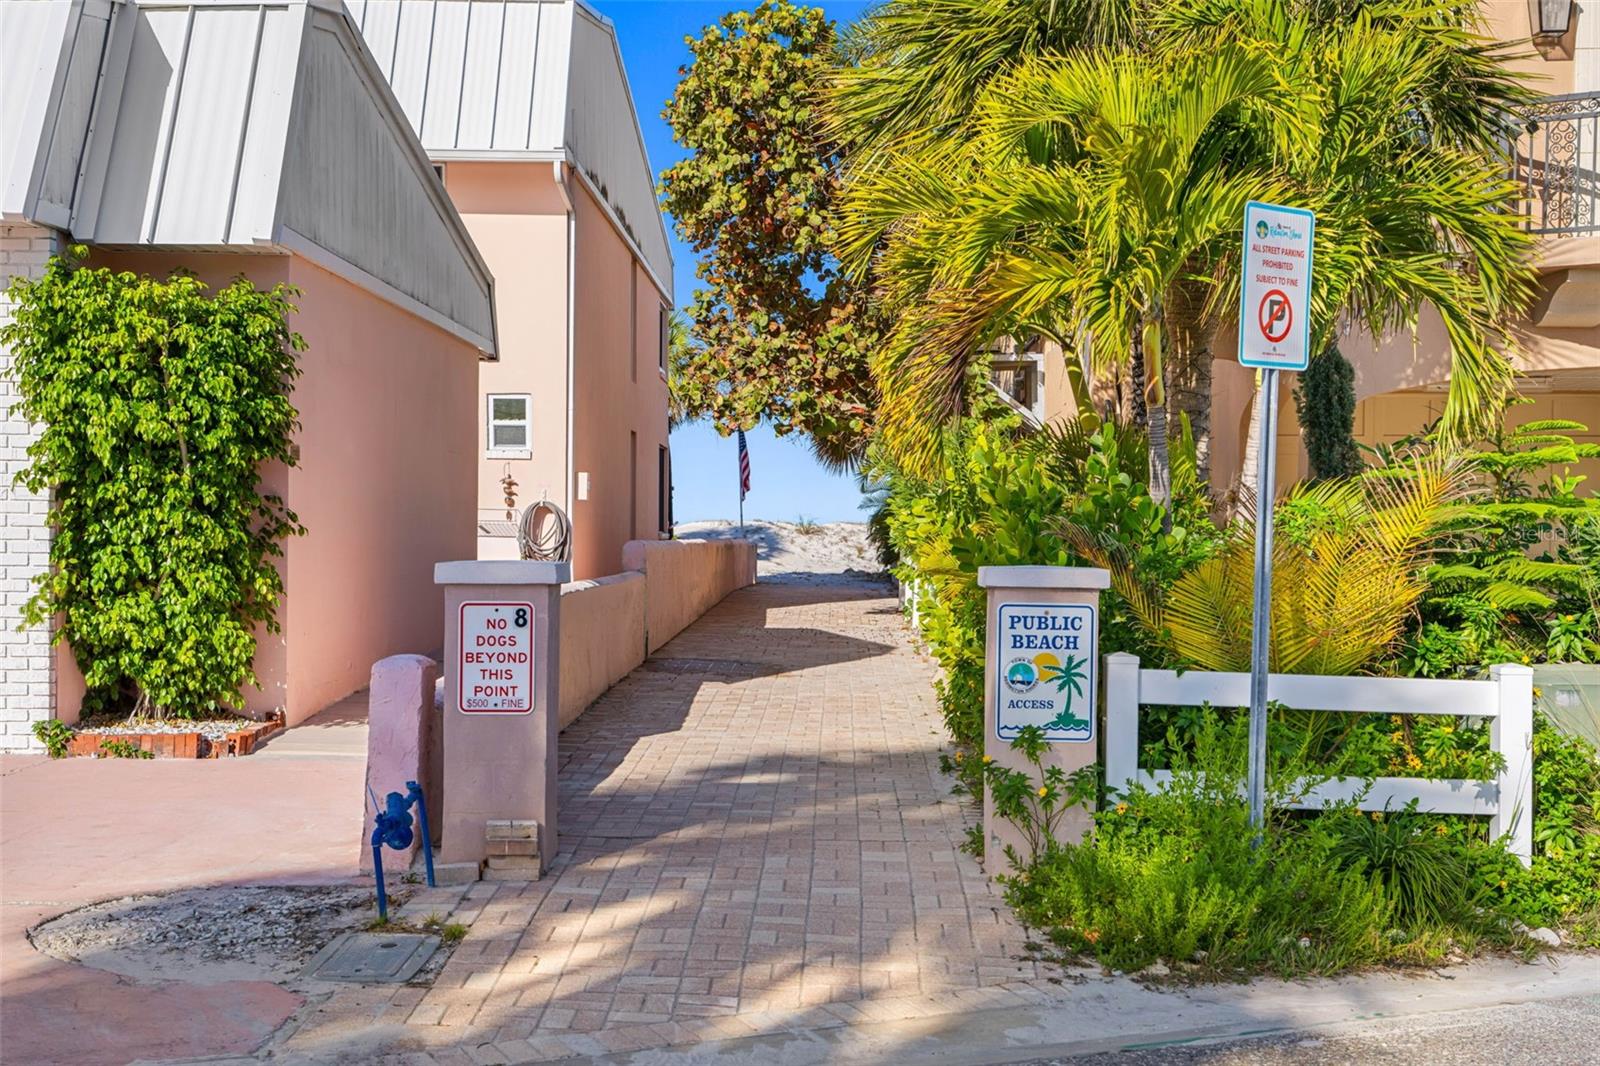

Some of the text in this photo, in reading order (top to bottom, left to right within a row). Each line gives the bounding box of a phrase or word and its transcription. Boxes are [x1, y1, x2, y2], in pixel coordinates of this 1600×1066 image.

[1252, 243, 1305, 259] ALL STREET PARKING
[1262, 259, 1294, 271] PROHIBITED
[1256, 274, 1298, 287] SUBJECT TO FINE
[486, 618, 507, 630] NO
[514, 608, 528, 628] 8
[1008, 615, 1083, 631] PUBLIC
[476, 635, 517, 647] DOGS
[1011, 634, 1080, 650] BEACH
[465, 652, 528, 664] BEYOND
[480, 668, 514, 680] THIS
[474, 685, 518, 697] POINT
[466, 698, 524, 708] $500 FINE
[1008, 699, 1054, 710] ACCESS
